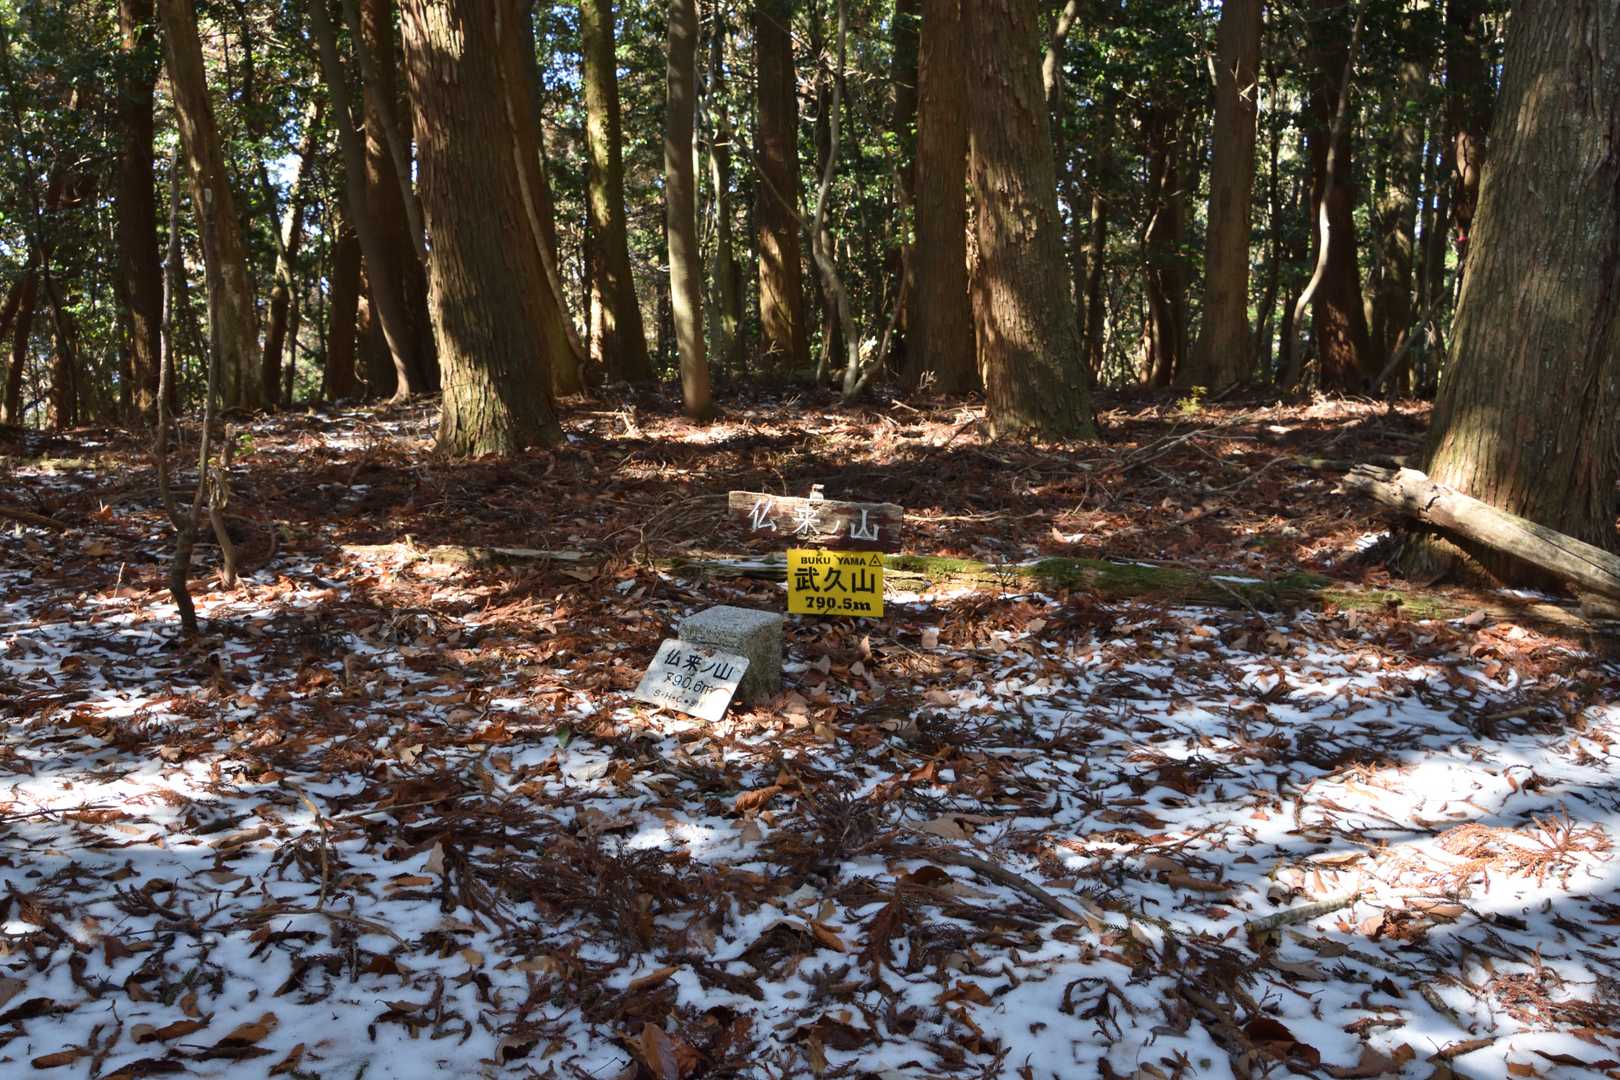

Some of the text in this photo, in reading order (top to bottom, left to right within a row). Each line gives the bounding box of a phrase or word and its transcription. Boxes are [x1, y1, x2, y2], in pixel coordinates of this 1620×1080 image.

[801, 556, 866, 566] BUKU YAMA
[794, 566, 875, 594] 武久山
[805, 596, 872, 611] 790.5m
[664, 649, 734, 681] 仏来ノ山
